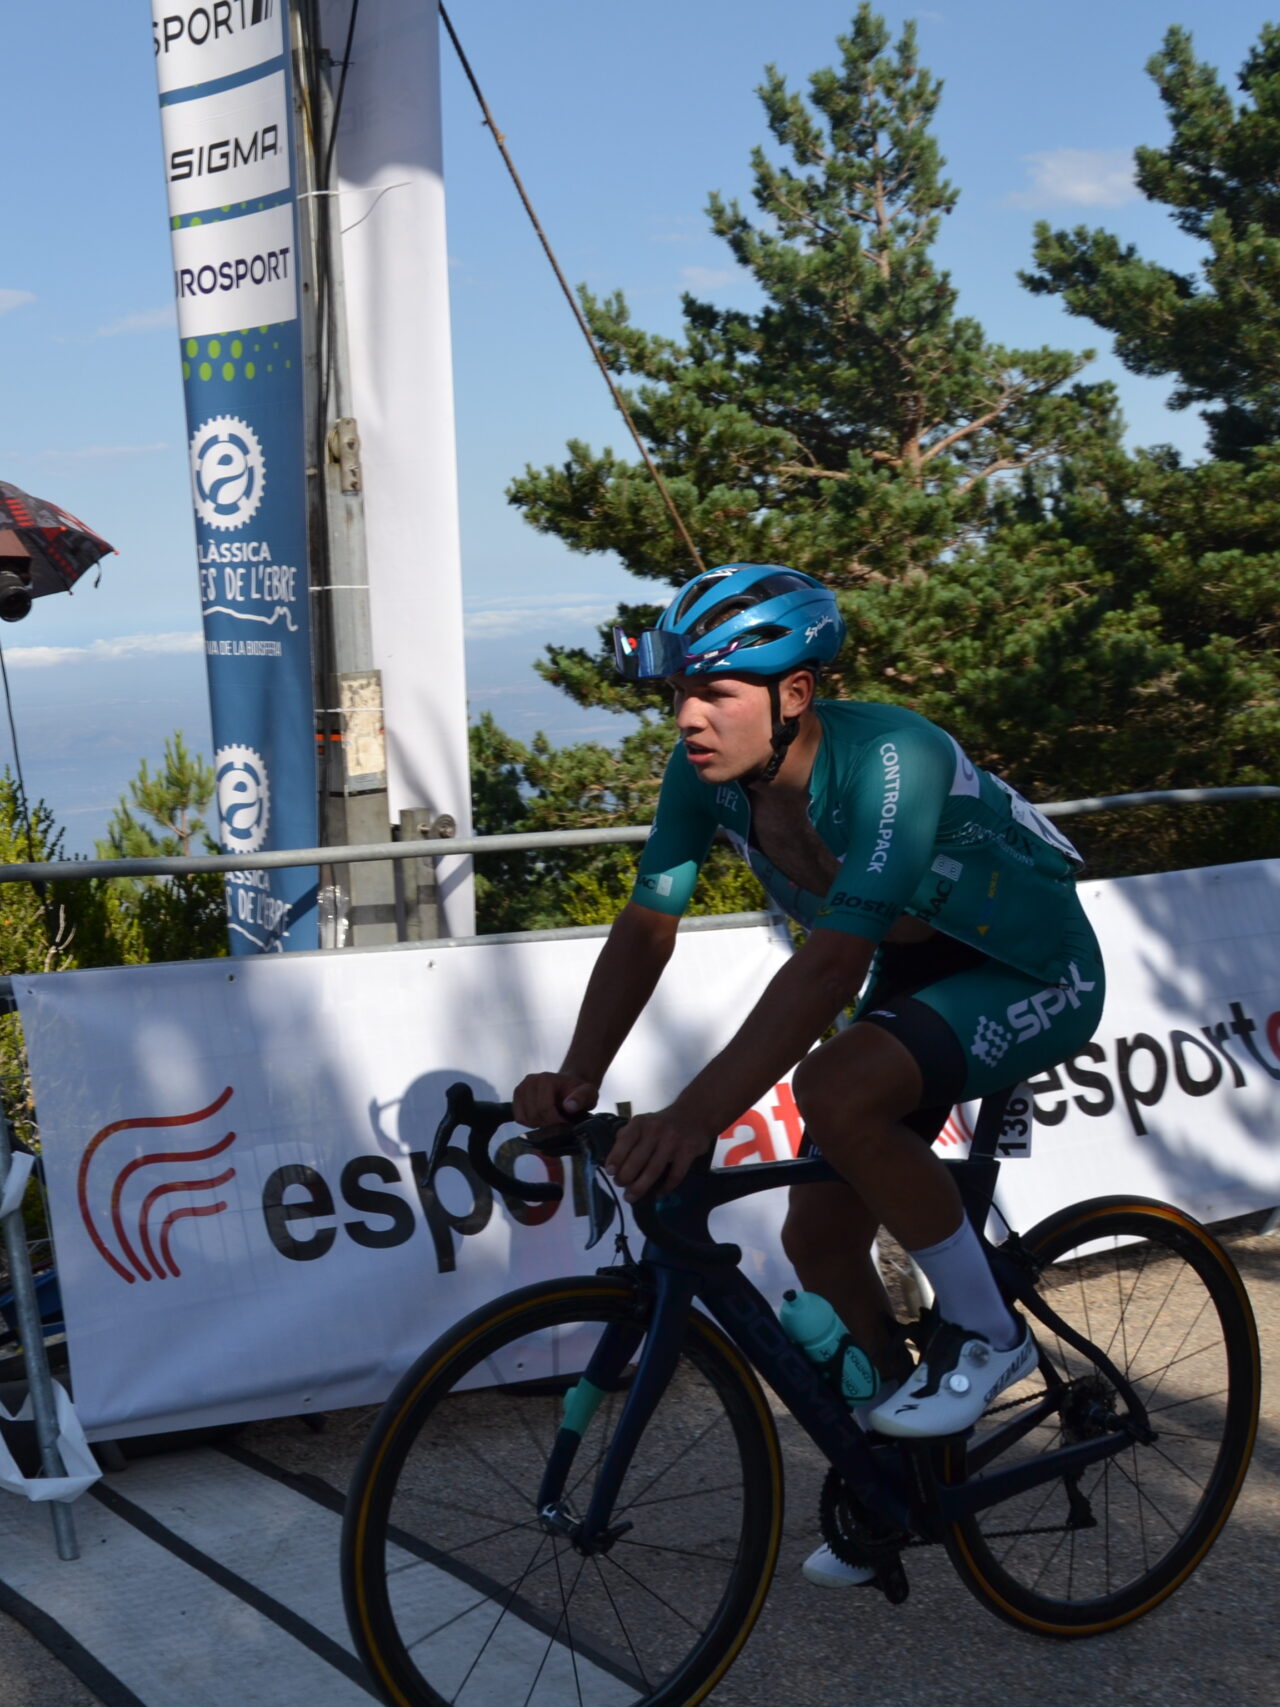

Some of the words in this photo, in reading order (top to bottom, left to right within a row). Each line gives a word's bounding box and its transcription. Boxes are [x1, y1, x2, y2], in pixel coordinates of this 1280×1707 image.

[170, 124, 278, 182] SIGMA
[224, 566, 247, 602] DE
[866, 742, 901, 874] CONTROLPACK
[997, 1097, 1029, 1157] 136
